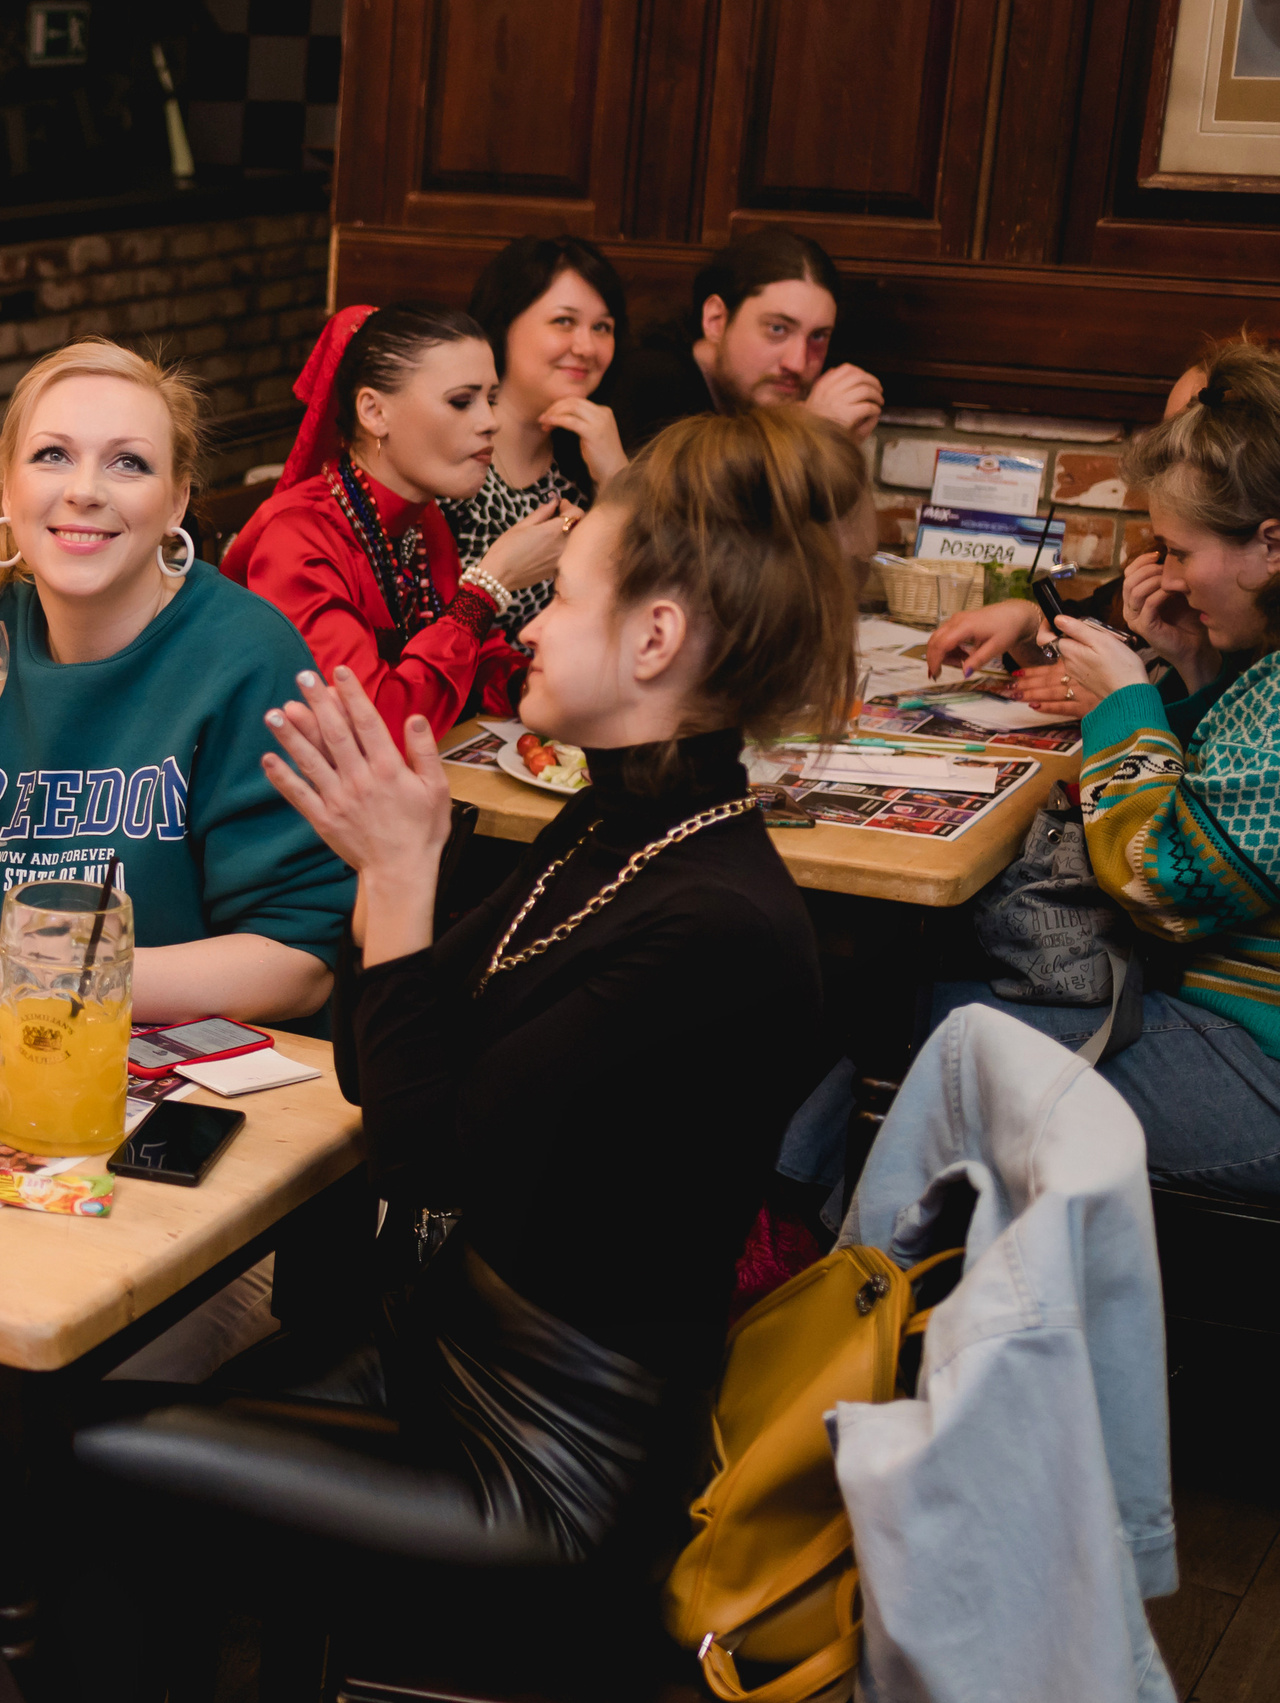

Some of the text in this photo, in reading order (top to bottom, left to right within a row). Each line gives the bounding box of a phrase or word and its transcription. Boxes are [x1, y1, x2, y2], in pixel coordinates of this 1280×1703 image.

[940, 538, 1016, 562] РОЗОВАЯ
[31, 853, 59, 866] AND
[61, 848, 116, 863] FOREVER
[3, 864, 56, 892] STATE
[59, 867, 77, 881] OF
[1055, 974, 1087, 991] 사랑
[20, 1013, 75, 1035] AXIMILIAN'S
